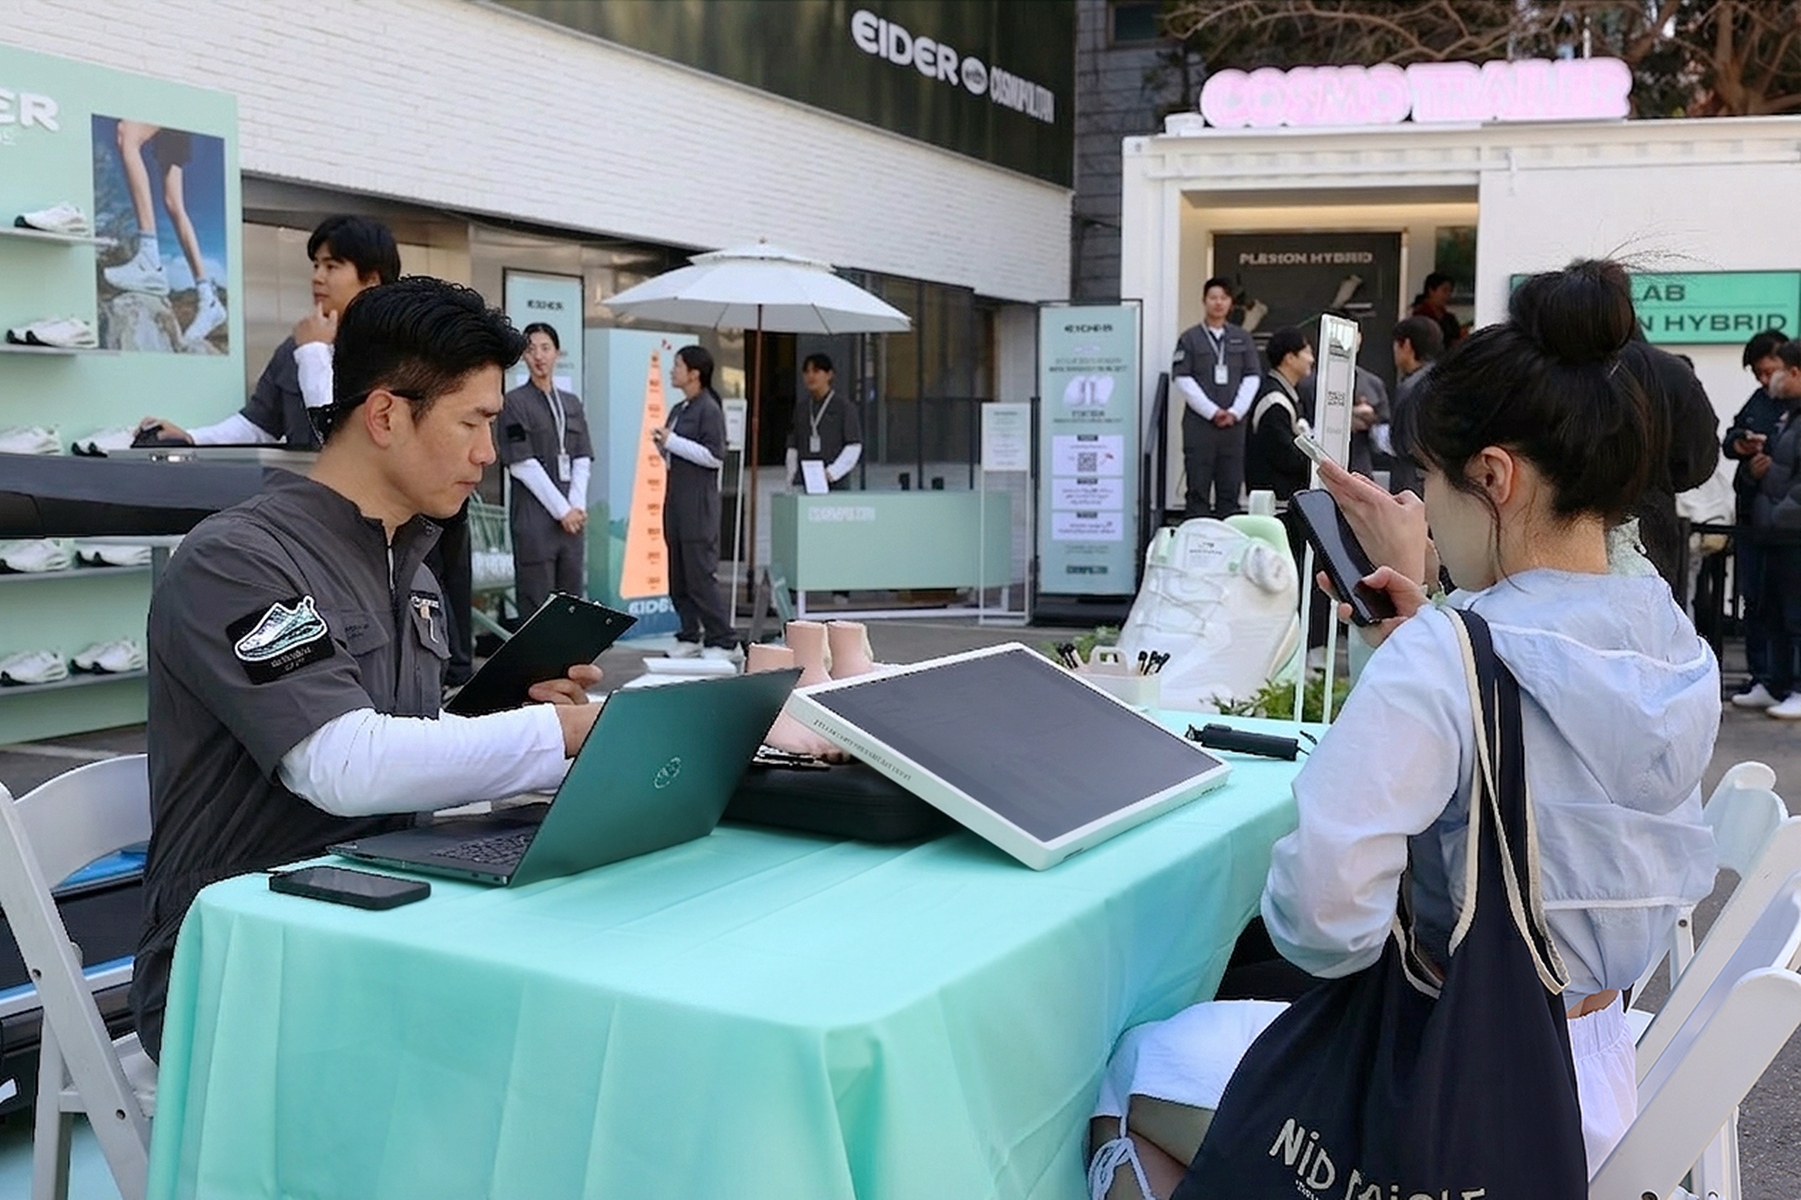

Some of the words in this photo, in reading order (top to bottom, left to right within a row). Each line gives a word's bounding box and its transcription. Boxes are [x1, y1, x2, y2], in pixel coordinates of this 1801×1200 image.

[851, 9, 959, 87] EIDER
[1201, 67, 1412, 127] COSMO
[1633, 284, 1686, 302] AB
[1664, 313, 1788, 332] HYBRID
